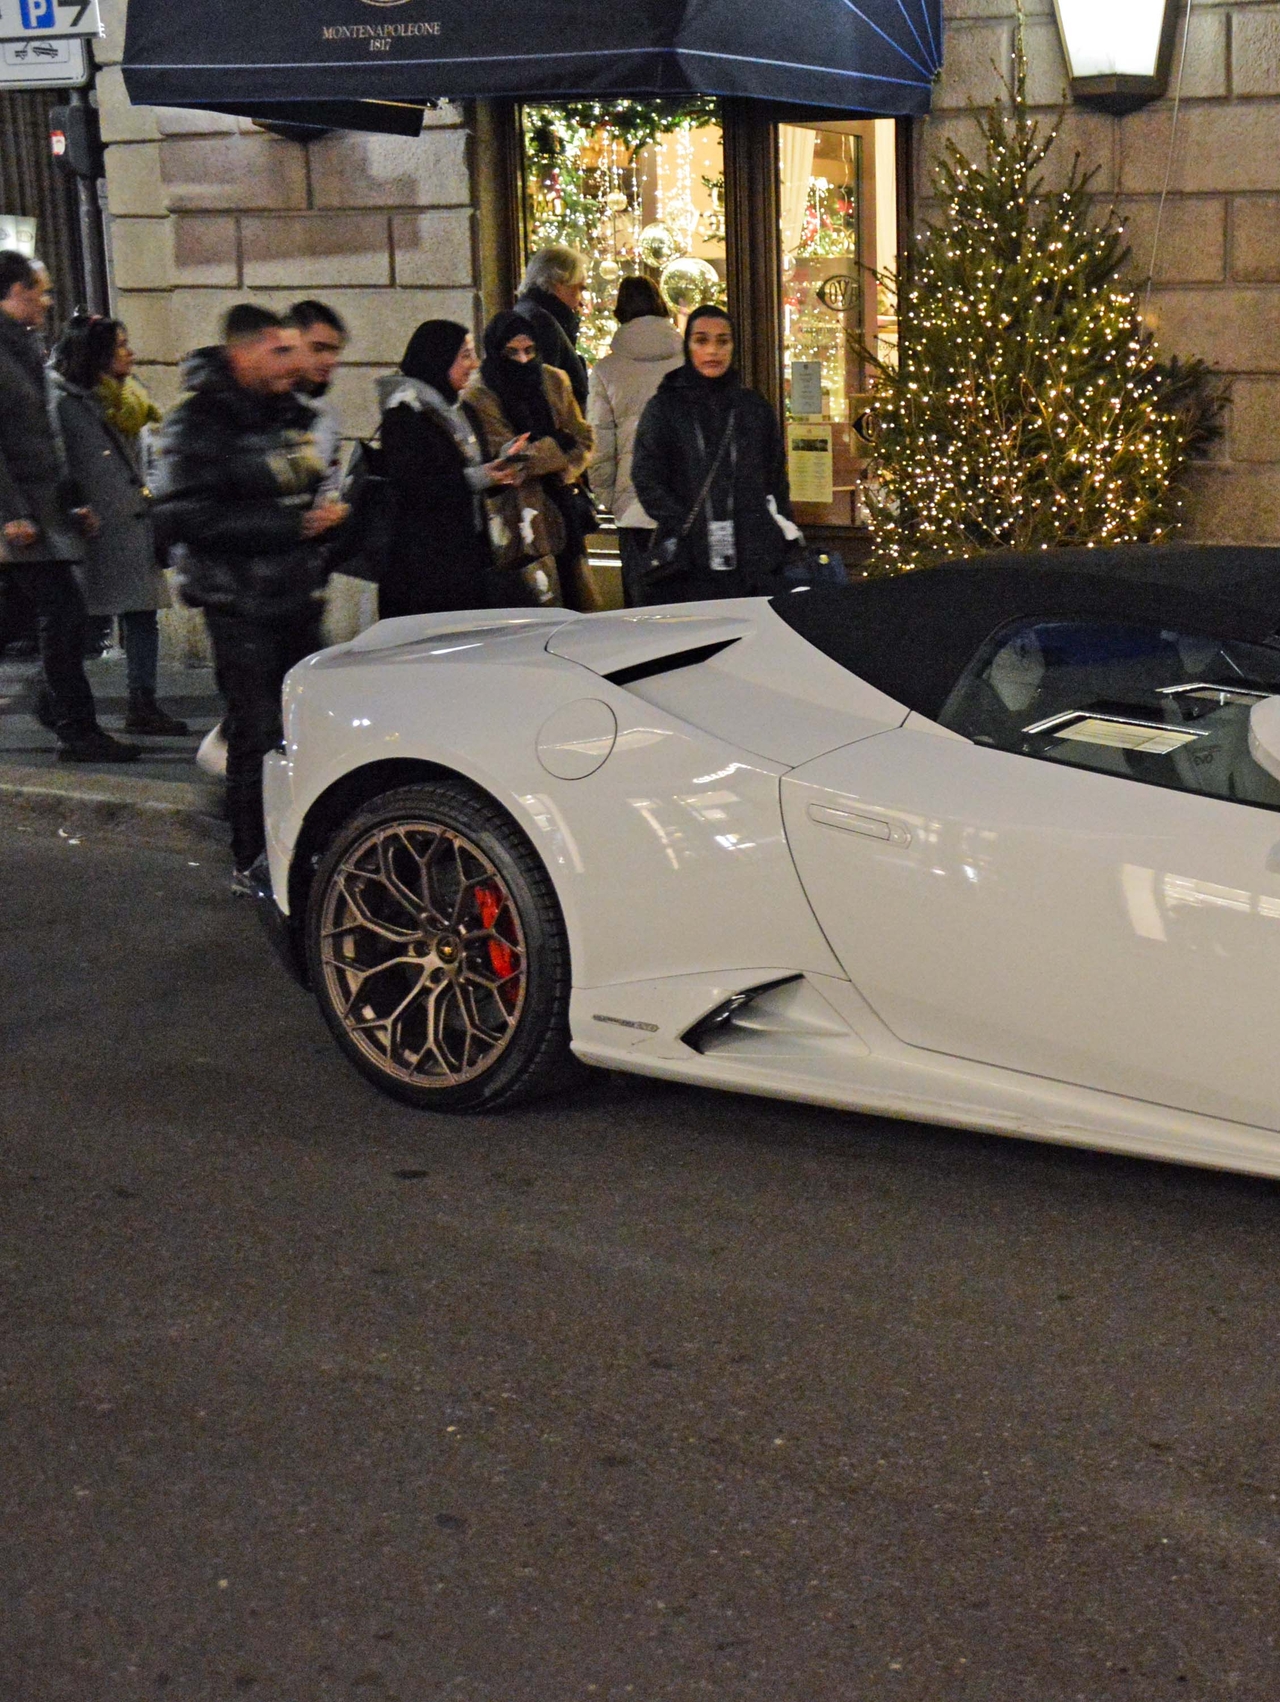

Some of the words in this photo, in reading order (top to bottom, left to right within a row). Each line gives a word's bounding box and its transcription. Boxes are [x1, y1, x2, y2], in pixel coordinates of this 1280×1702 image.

[27, 0, 47, 27] P
[322, 22, 441, 39] MONTENAPOLEONE
[369, 39, 391, 51] 1817
